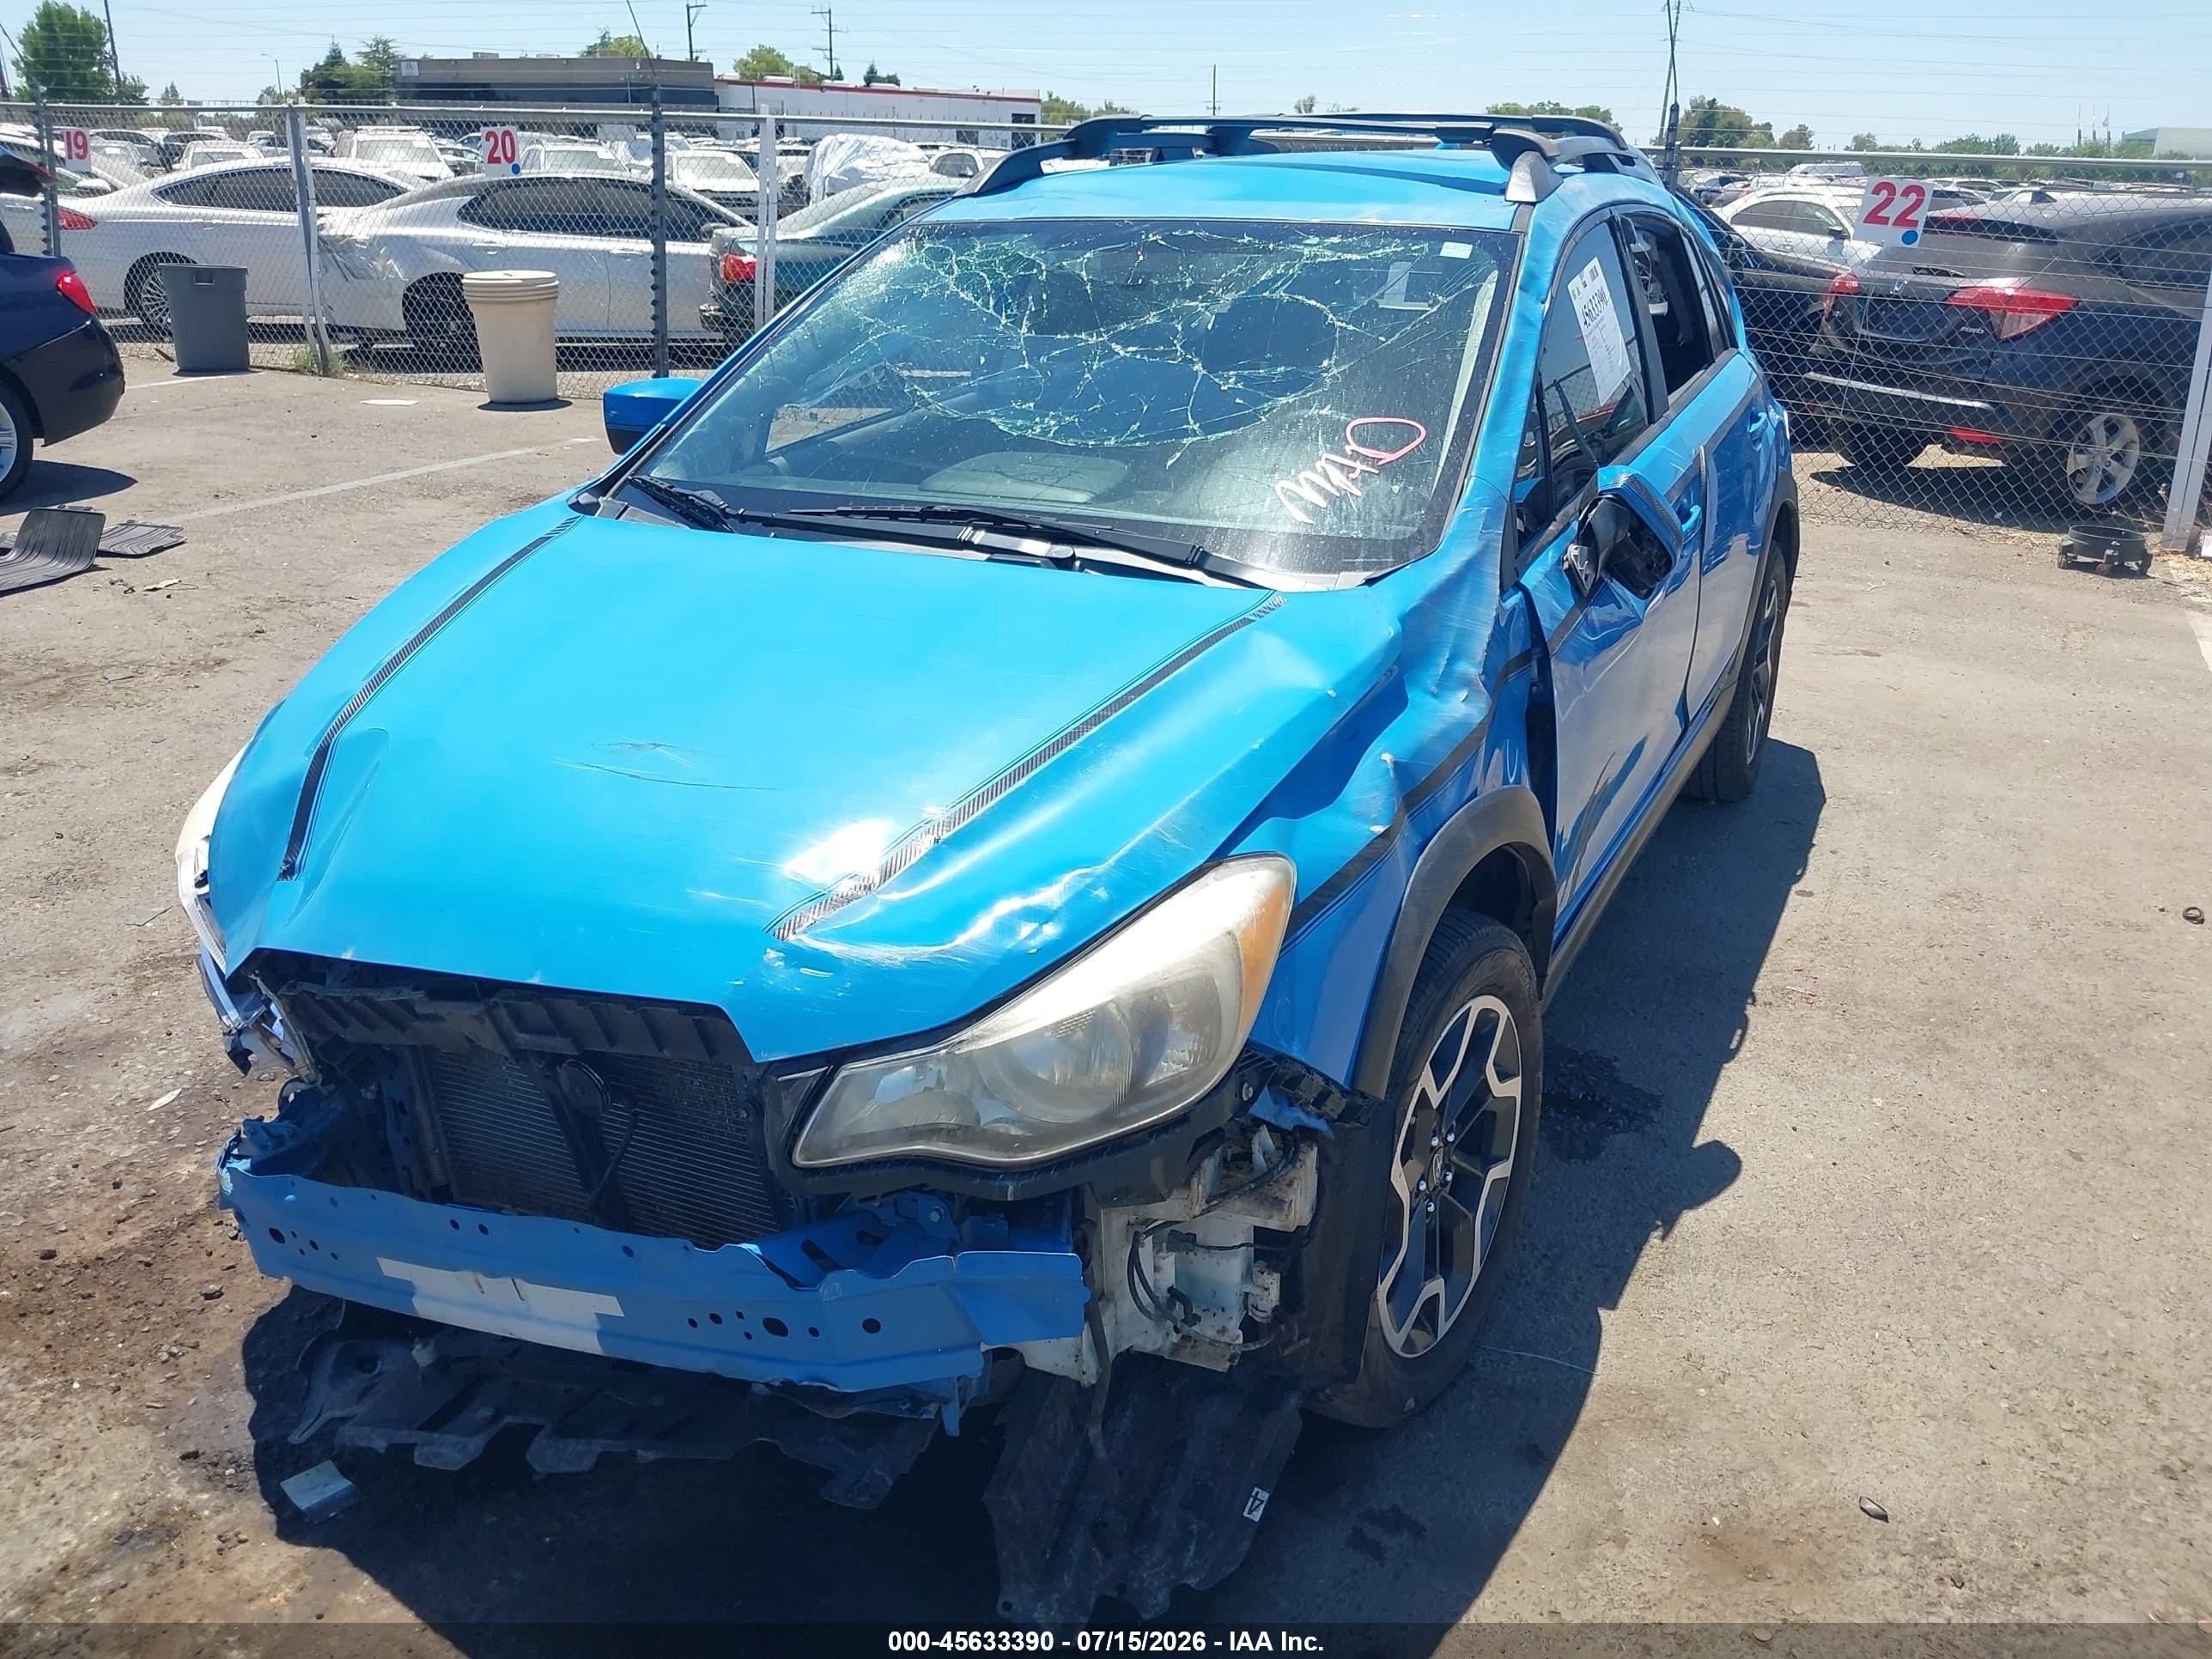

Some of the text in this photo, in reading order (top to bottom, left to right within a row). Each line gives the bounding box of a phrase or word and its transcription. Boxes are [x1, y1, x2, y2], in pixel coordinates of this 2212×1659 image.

[66, 131, 88, 160] 19
[485, 130, 516, 164] 20
[1863, 181, 1925, 229] 22
